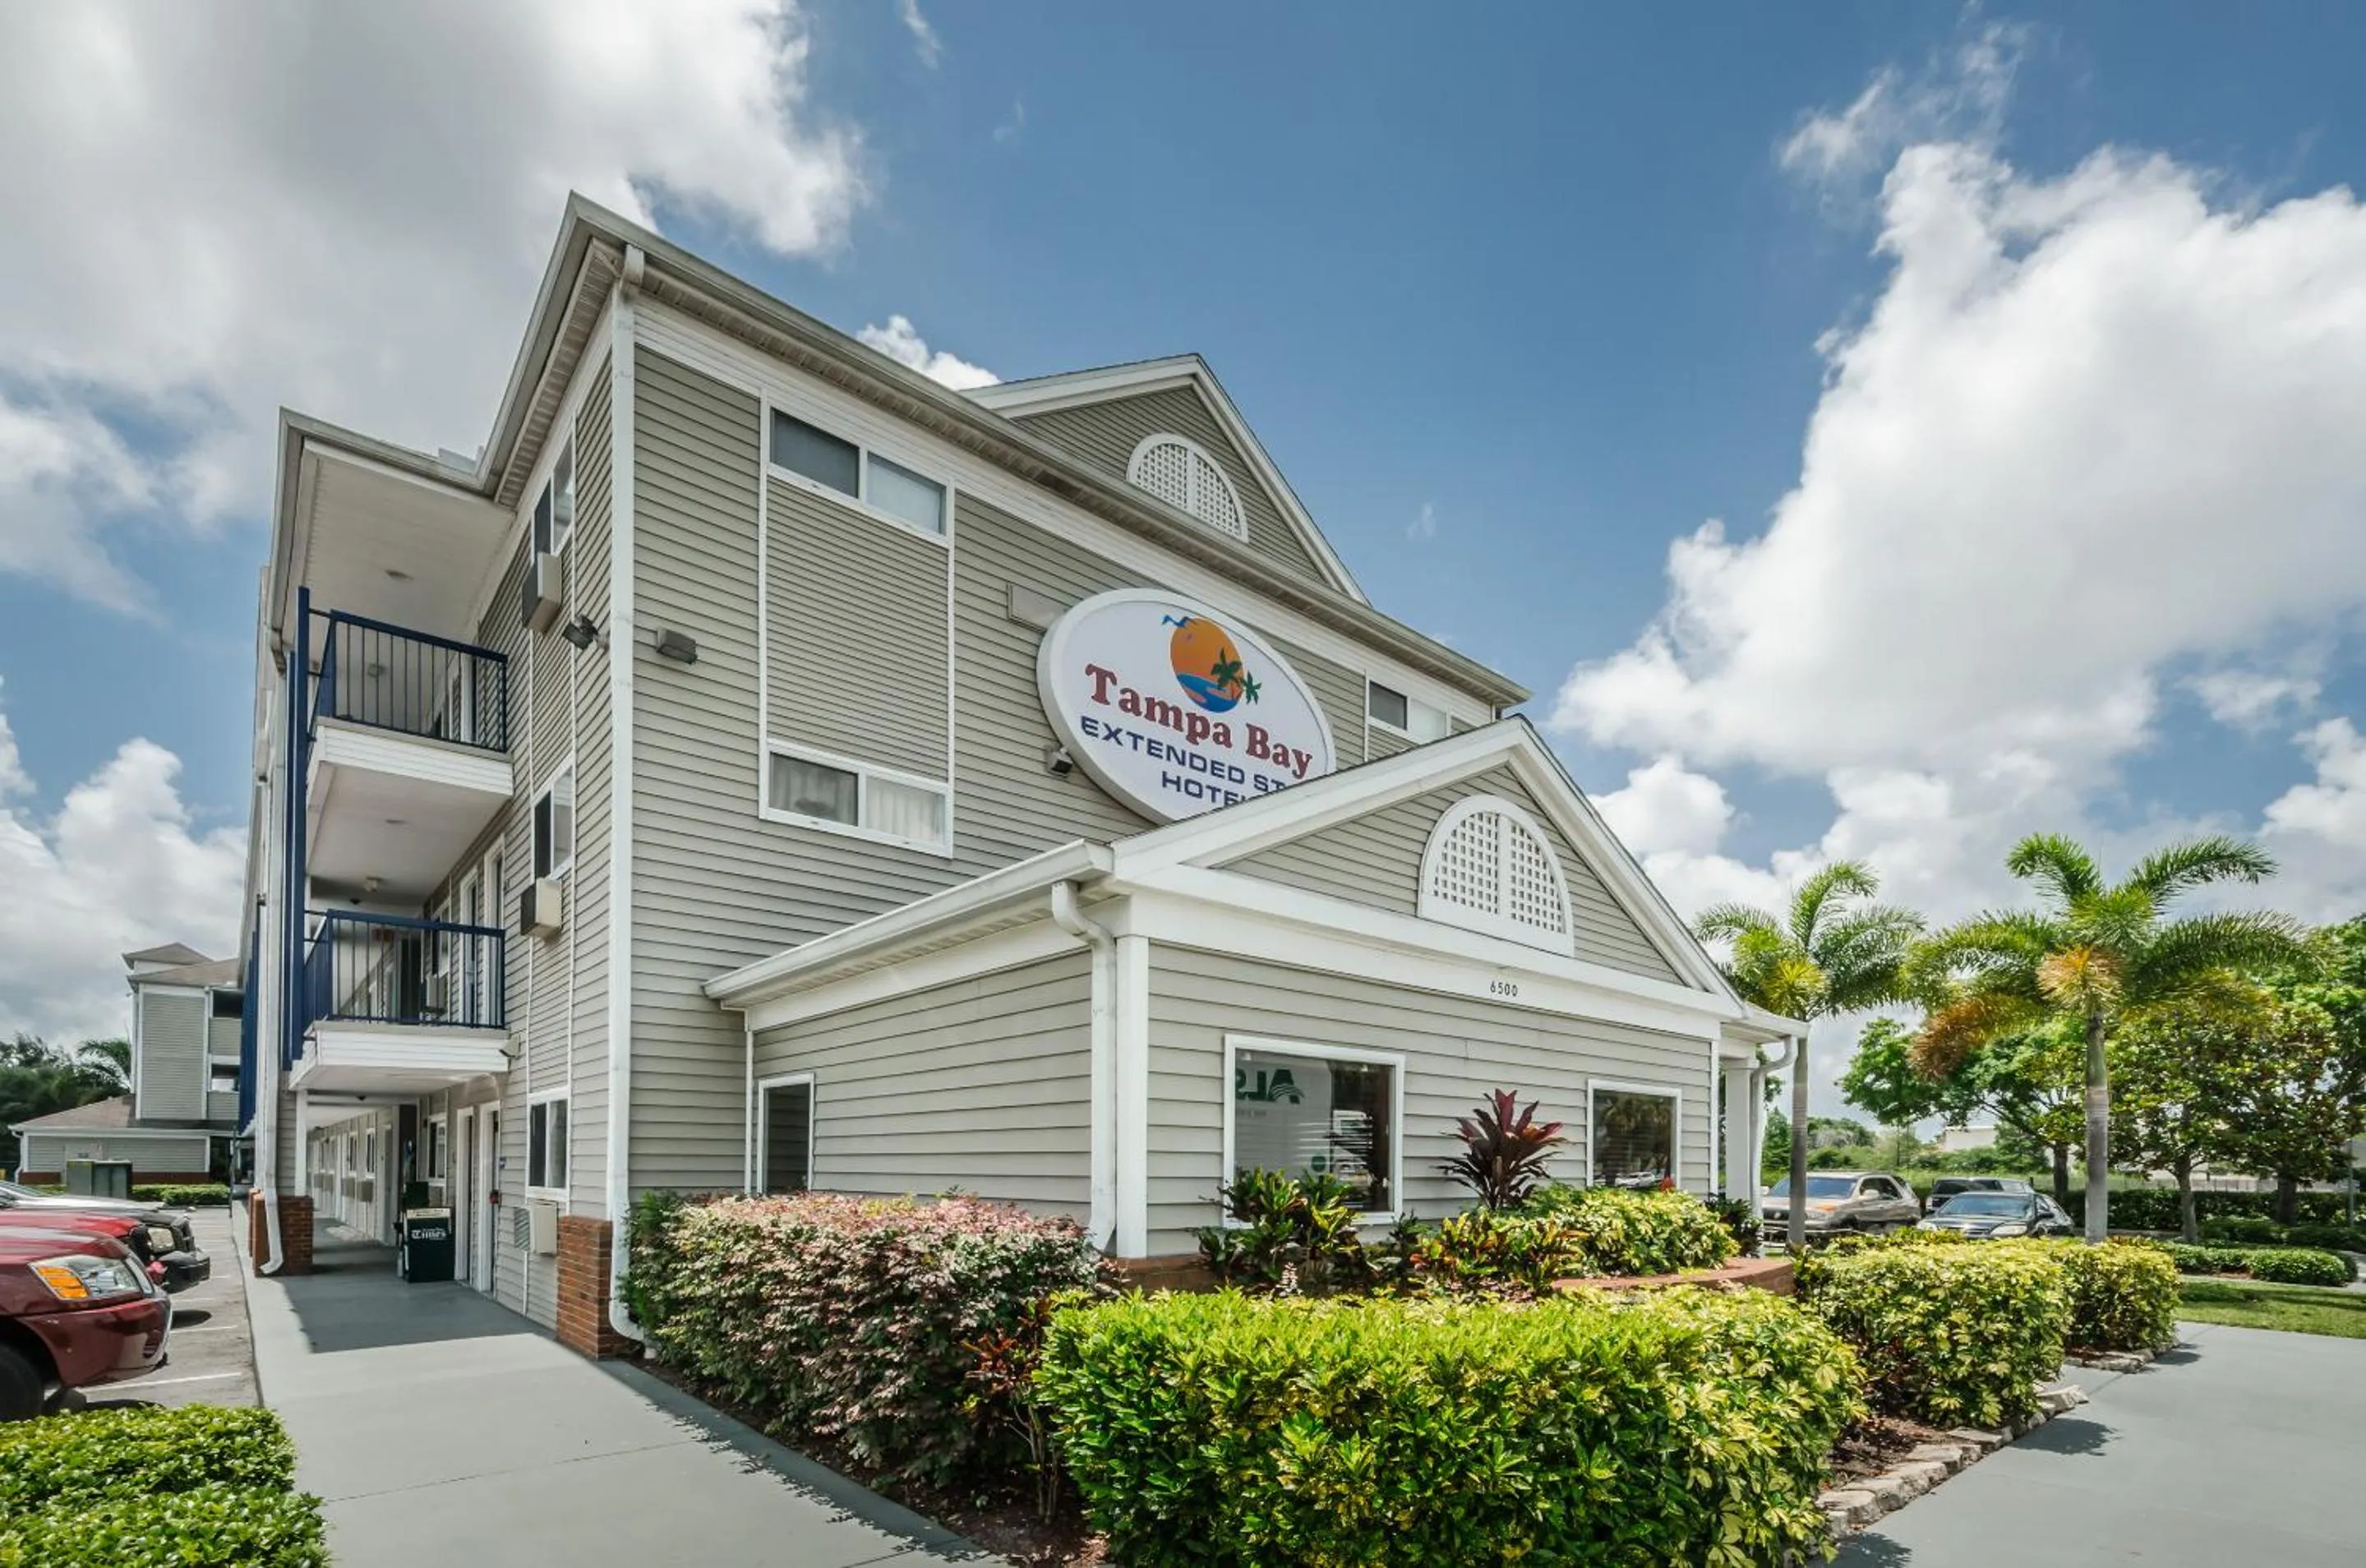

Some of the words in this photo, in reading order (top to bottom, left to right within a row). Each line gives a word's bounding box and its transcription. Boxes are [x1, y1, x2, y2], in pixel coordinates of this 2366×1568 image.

[1085, 663, 1233, 749] Tampa
[1245, 722, 1312, 780] Bay
[1081, 715, 1245, 785] EXTENDED
[1254, 773, 1287, 792] ST
[1161, 770, 1248, 807] HOTE
[1490, 980, 1518, 997] 6500
